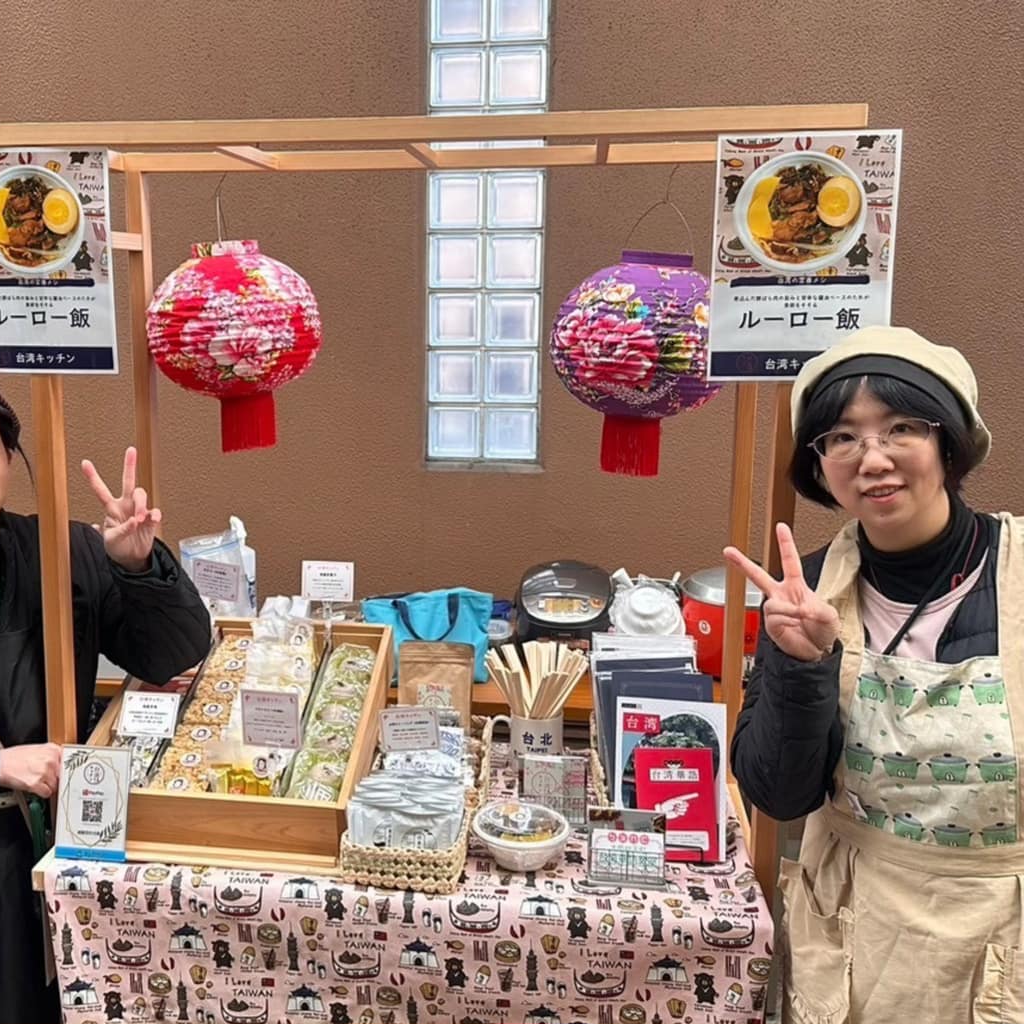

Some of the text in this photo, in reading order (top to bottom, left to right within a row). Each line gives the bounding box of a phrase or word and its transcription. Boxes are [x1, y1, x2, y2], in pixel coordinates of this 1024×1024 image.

[739, 308, 860, 330] ルーロー飯
[15, 352, 76, 364] 台湾キッチン
[765, 358, 801, 370] 台湾キ
[626, 716, 657, 730] 台湾
[522, 731, 553, 746] 台北
[228, 876, 270, 885] TAIWAN
[464, 893, 507, 901] TAIWAN
[117, 928, 156, 938] TAIWAN
[344, 941, 386, 951] TAIWAN
[587, 960, 632, 969] TAIWAN
[232, 989, 273, 998] TAIWAN
[465, 1007, 509, 1017] TAIWAN
